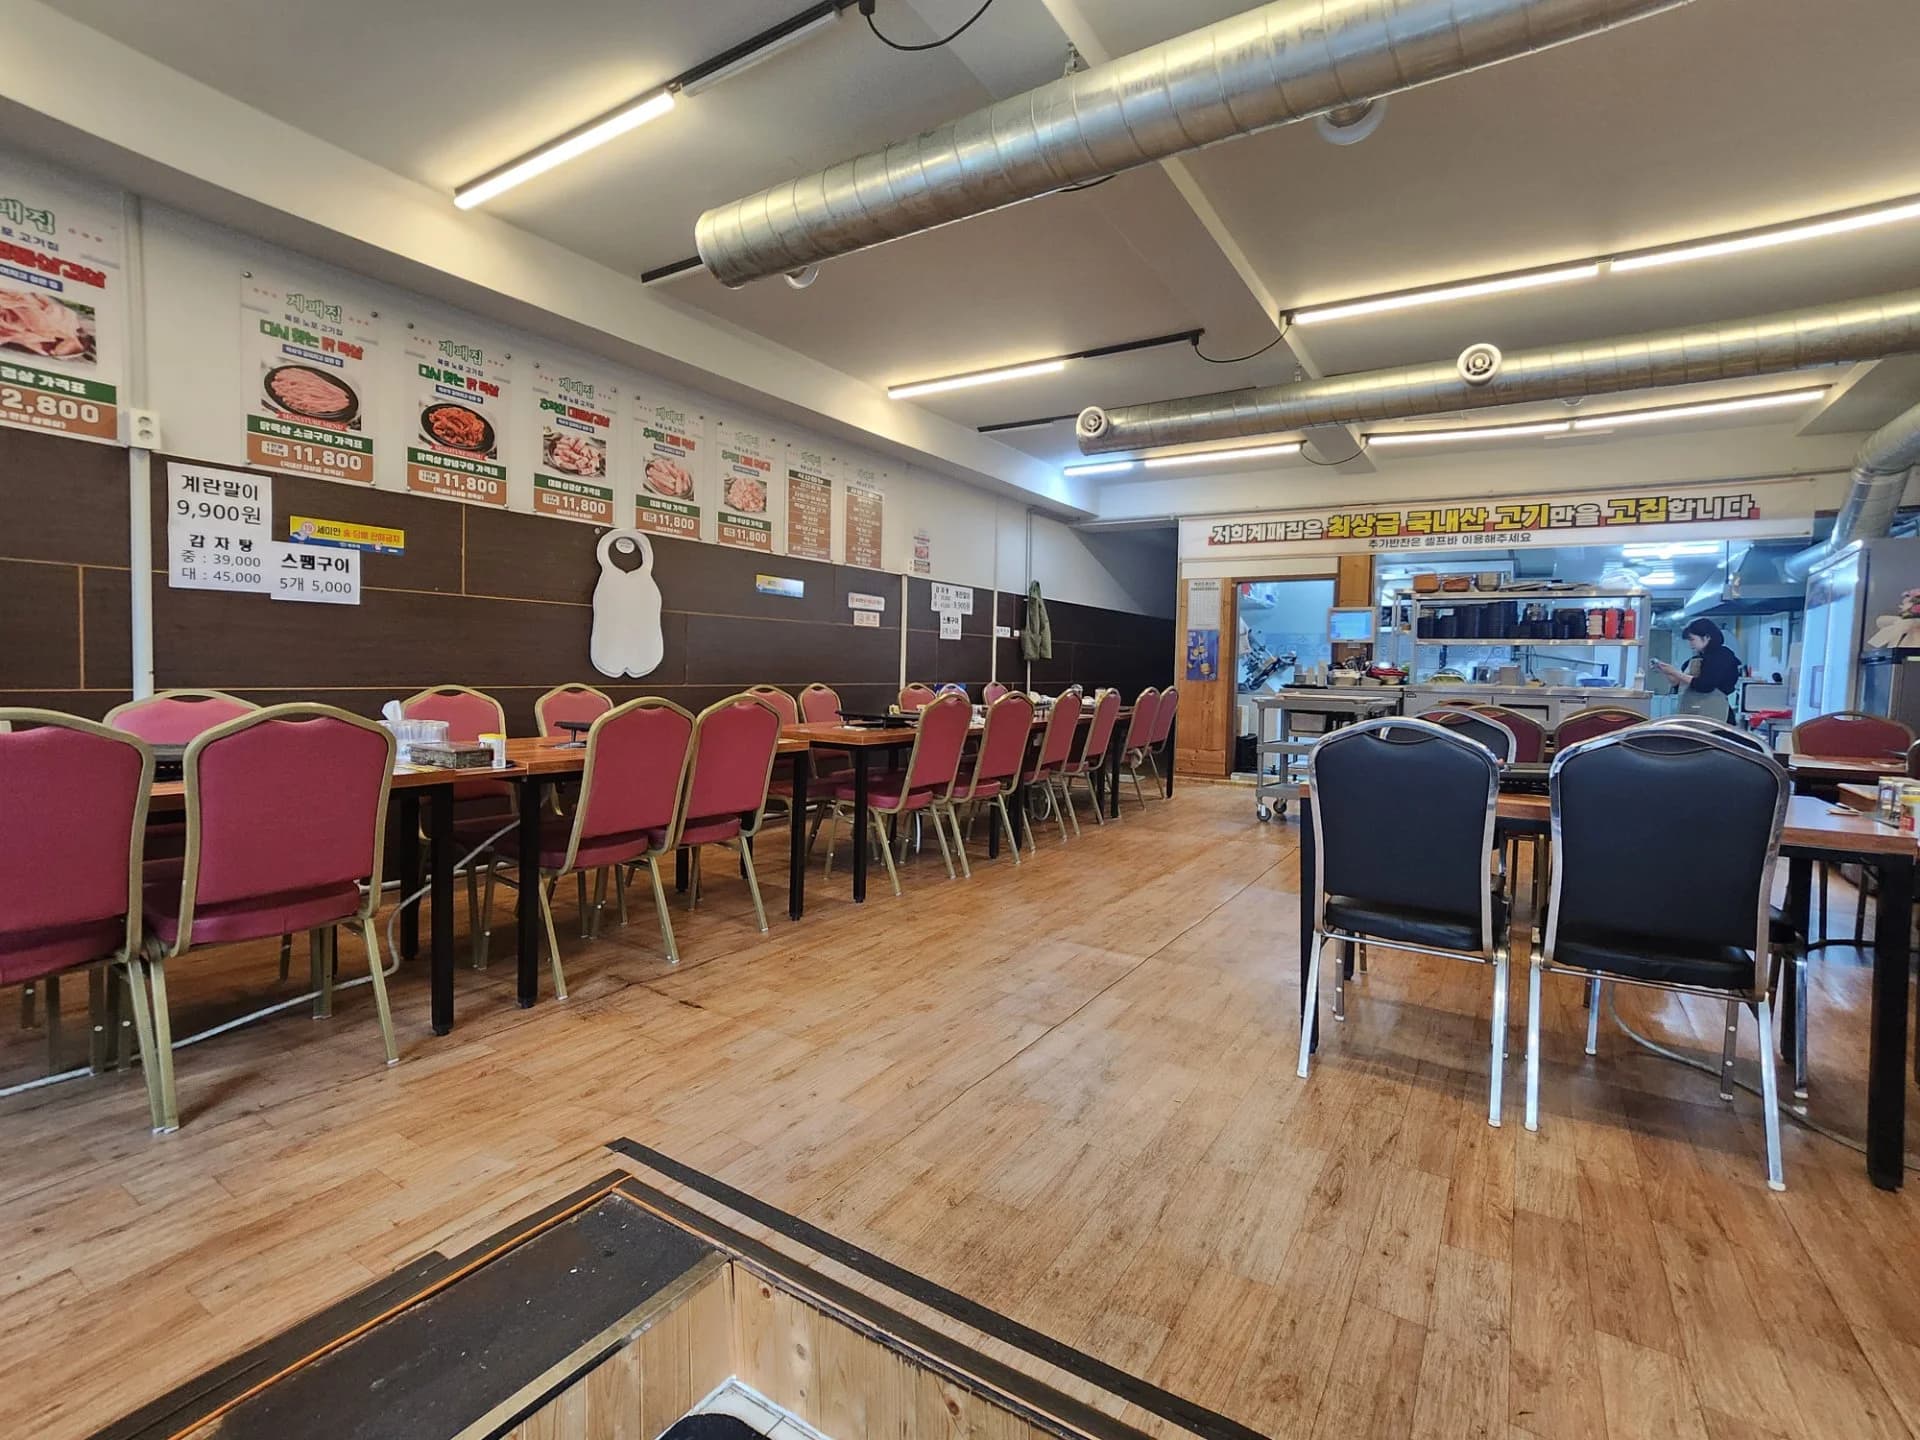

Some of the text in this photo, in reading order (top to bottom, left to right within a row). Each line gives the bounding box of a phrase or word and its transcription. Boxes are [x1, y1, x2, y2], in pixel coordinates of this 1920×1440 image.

[38, 374, 86, 394] 가격표
[1, 388, 99, 423] 2,800
[293, 428, 333, 443] 소금구이
[334, 436, 363, 449] 가격표
[293, 445, 361, 470] 11,800
[476, 464, 498, 476] 가격표
[181, 475, 258, 501] 계란말이
[443, 473, 498, 494] 11,800
[177, 499, 261, 525] 9,900원
[562, 495, 606, 514] 11,800
[1328, 511, 1401, 538] 최상급
[1406, 505, 1488, 534] 국내산
[1493, 502, 1600, 530] 고기만을
[1606, 494, 1753, 524] 고집합니다
[317, 525, 341, 536] 세미만
[1368, 532, 1532, 549] 추가반찬은 셀프바 이용해주세요
[213, 553, 261, 567] 39,000
[281, 553, 350, 574] 스팸구이
[182, 567, 196, 580] 대
[213, 570, 261, 583] 45,000
[279, 577, 352, 594] 5개 5,000
